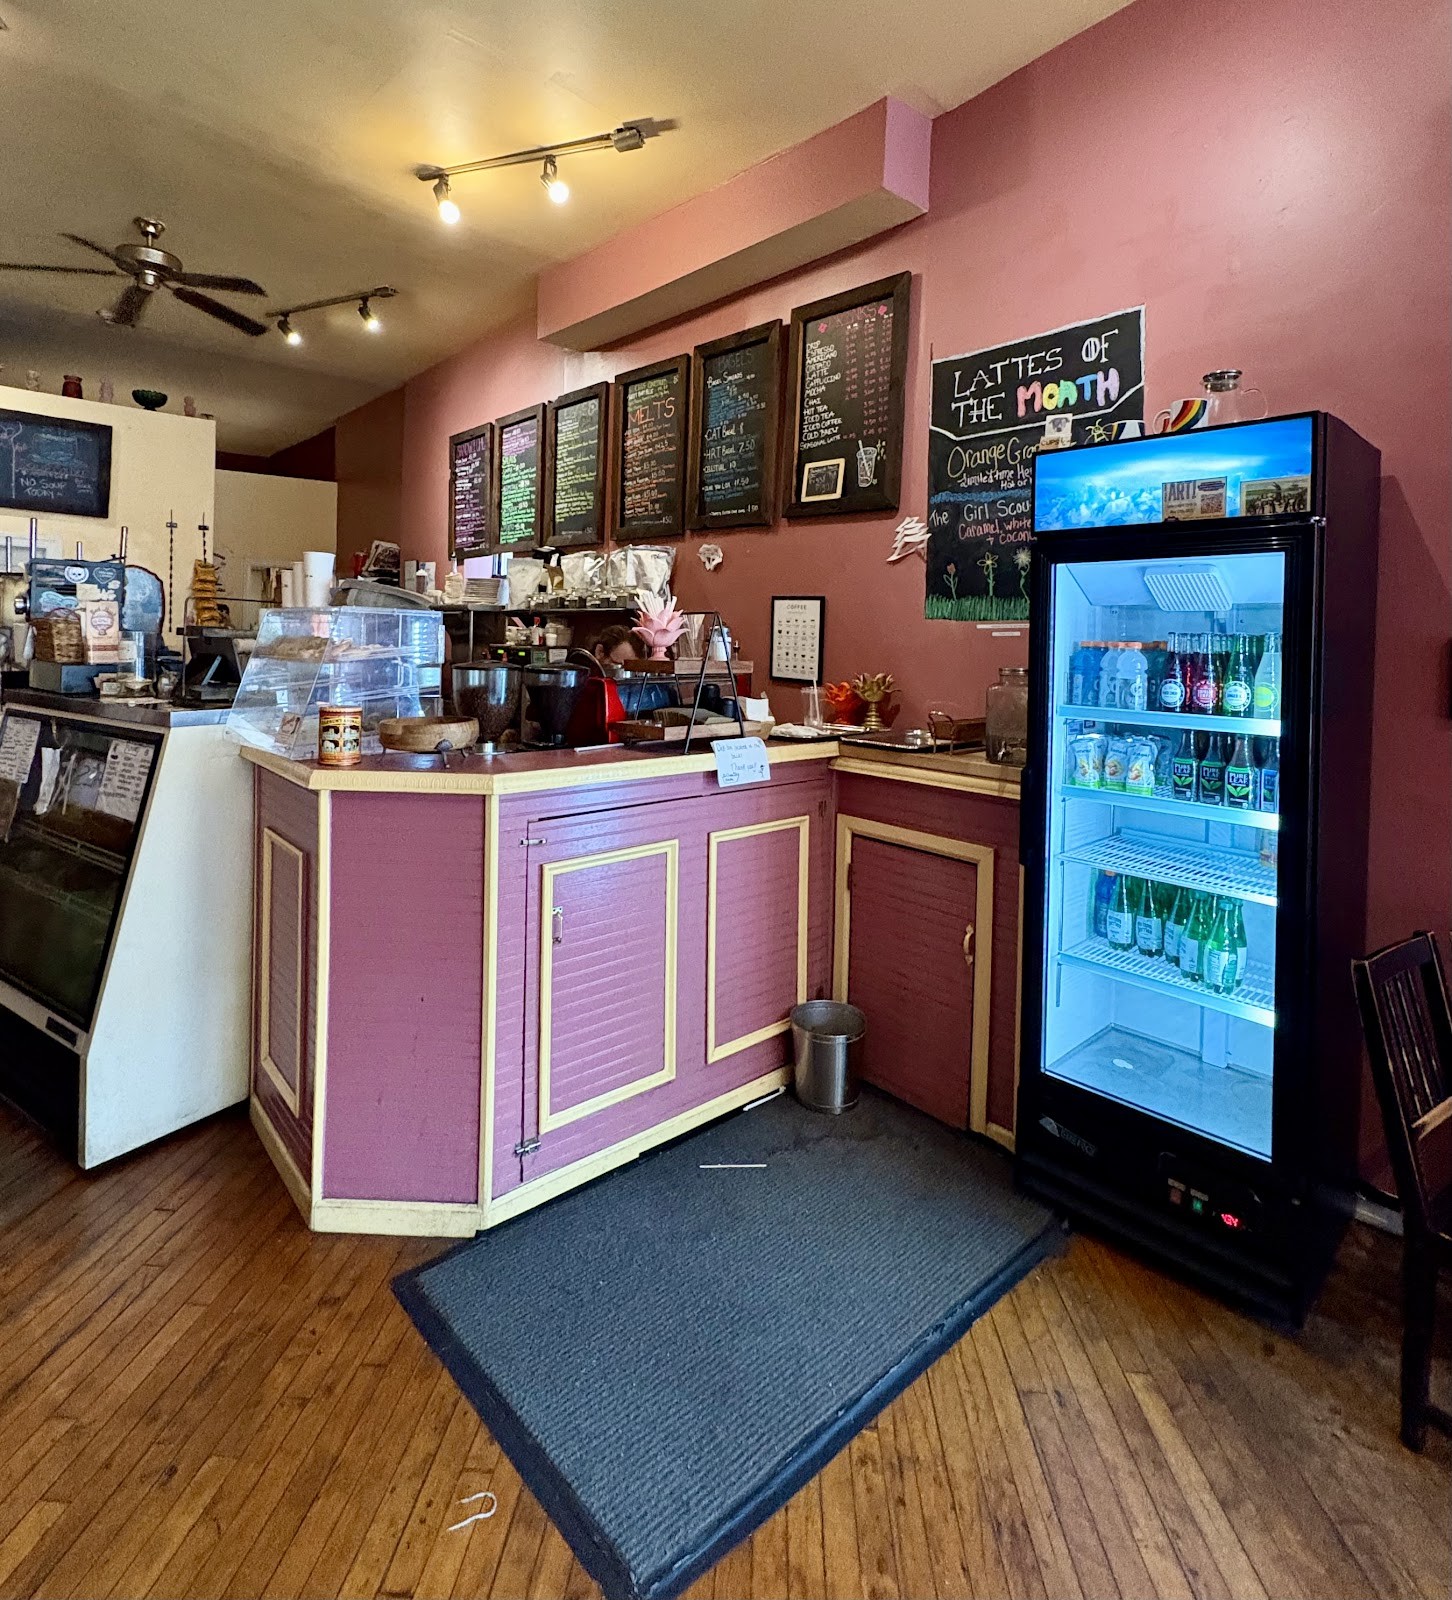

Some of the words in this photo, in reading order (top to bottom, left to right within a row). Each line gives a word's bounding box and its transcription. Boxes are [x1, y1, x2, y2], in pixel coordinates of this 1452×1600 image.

[806, 340, 821, 351] DRIP
[805, 360, 831, 374] CORTADO
[953, 346, 1063, 399] LATTES
[1081, 329, 1119, 364] OF
[805, 367, 829, 381] LATTE
[804, 385, 826, 398] MOCHA
[951, 391, 1006, 429] THE
[1016, 367, 1120, 419] MONTH
[804, 397, 821, 408] CHAI
[629, 397, 676, 425] MELTS
[803, 407, 815, 416] HOT
[816, 404, 828, 413] TEA
[820, 411, 835, 420] TEA
[820, 418, 843, 428] COFFEE
[802, 431, 819, 441] COLD
[819, 426, 839, 438] BREW
[947, 443, 1005, 478] Orange
[929, 509, 950, 527] The
[963, 503, 990, 522] Girl
[1229, 772, 1248, 780] PURE
